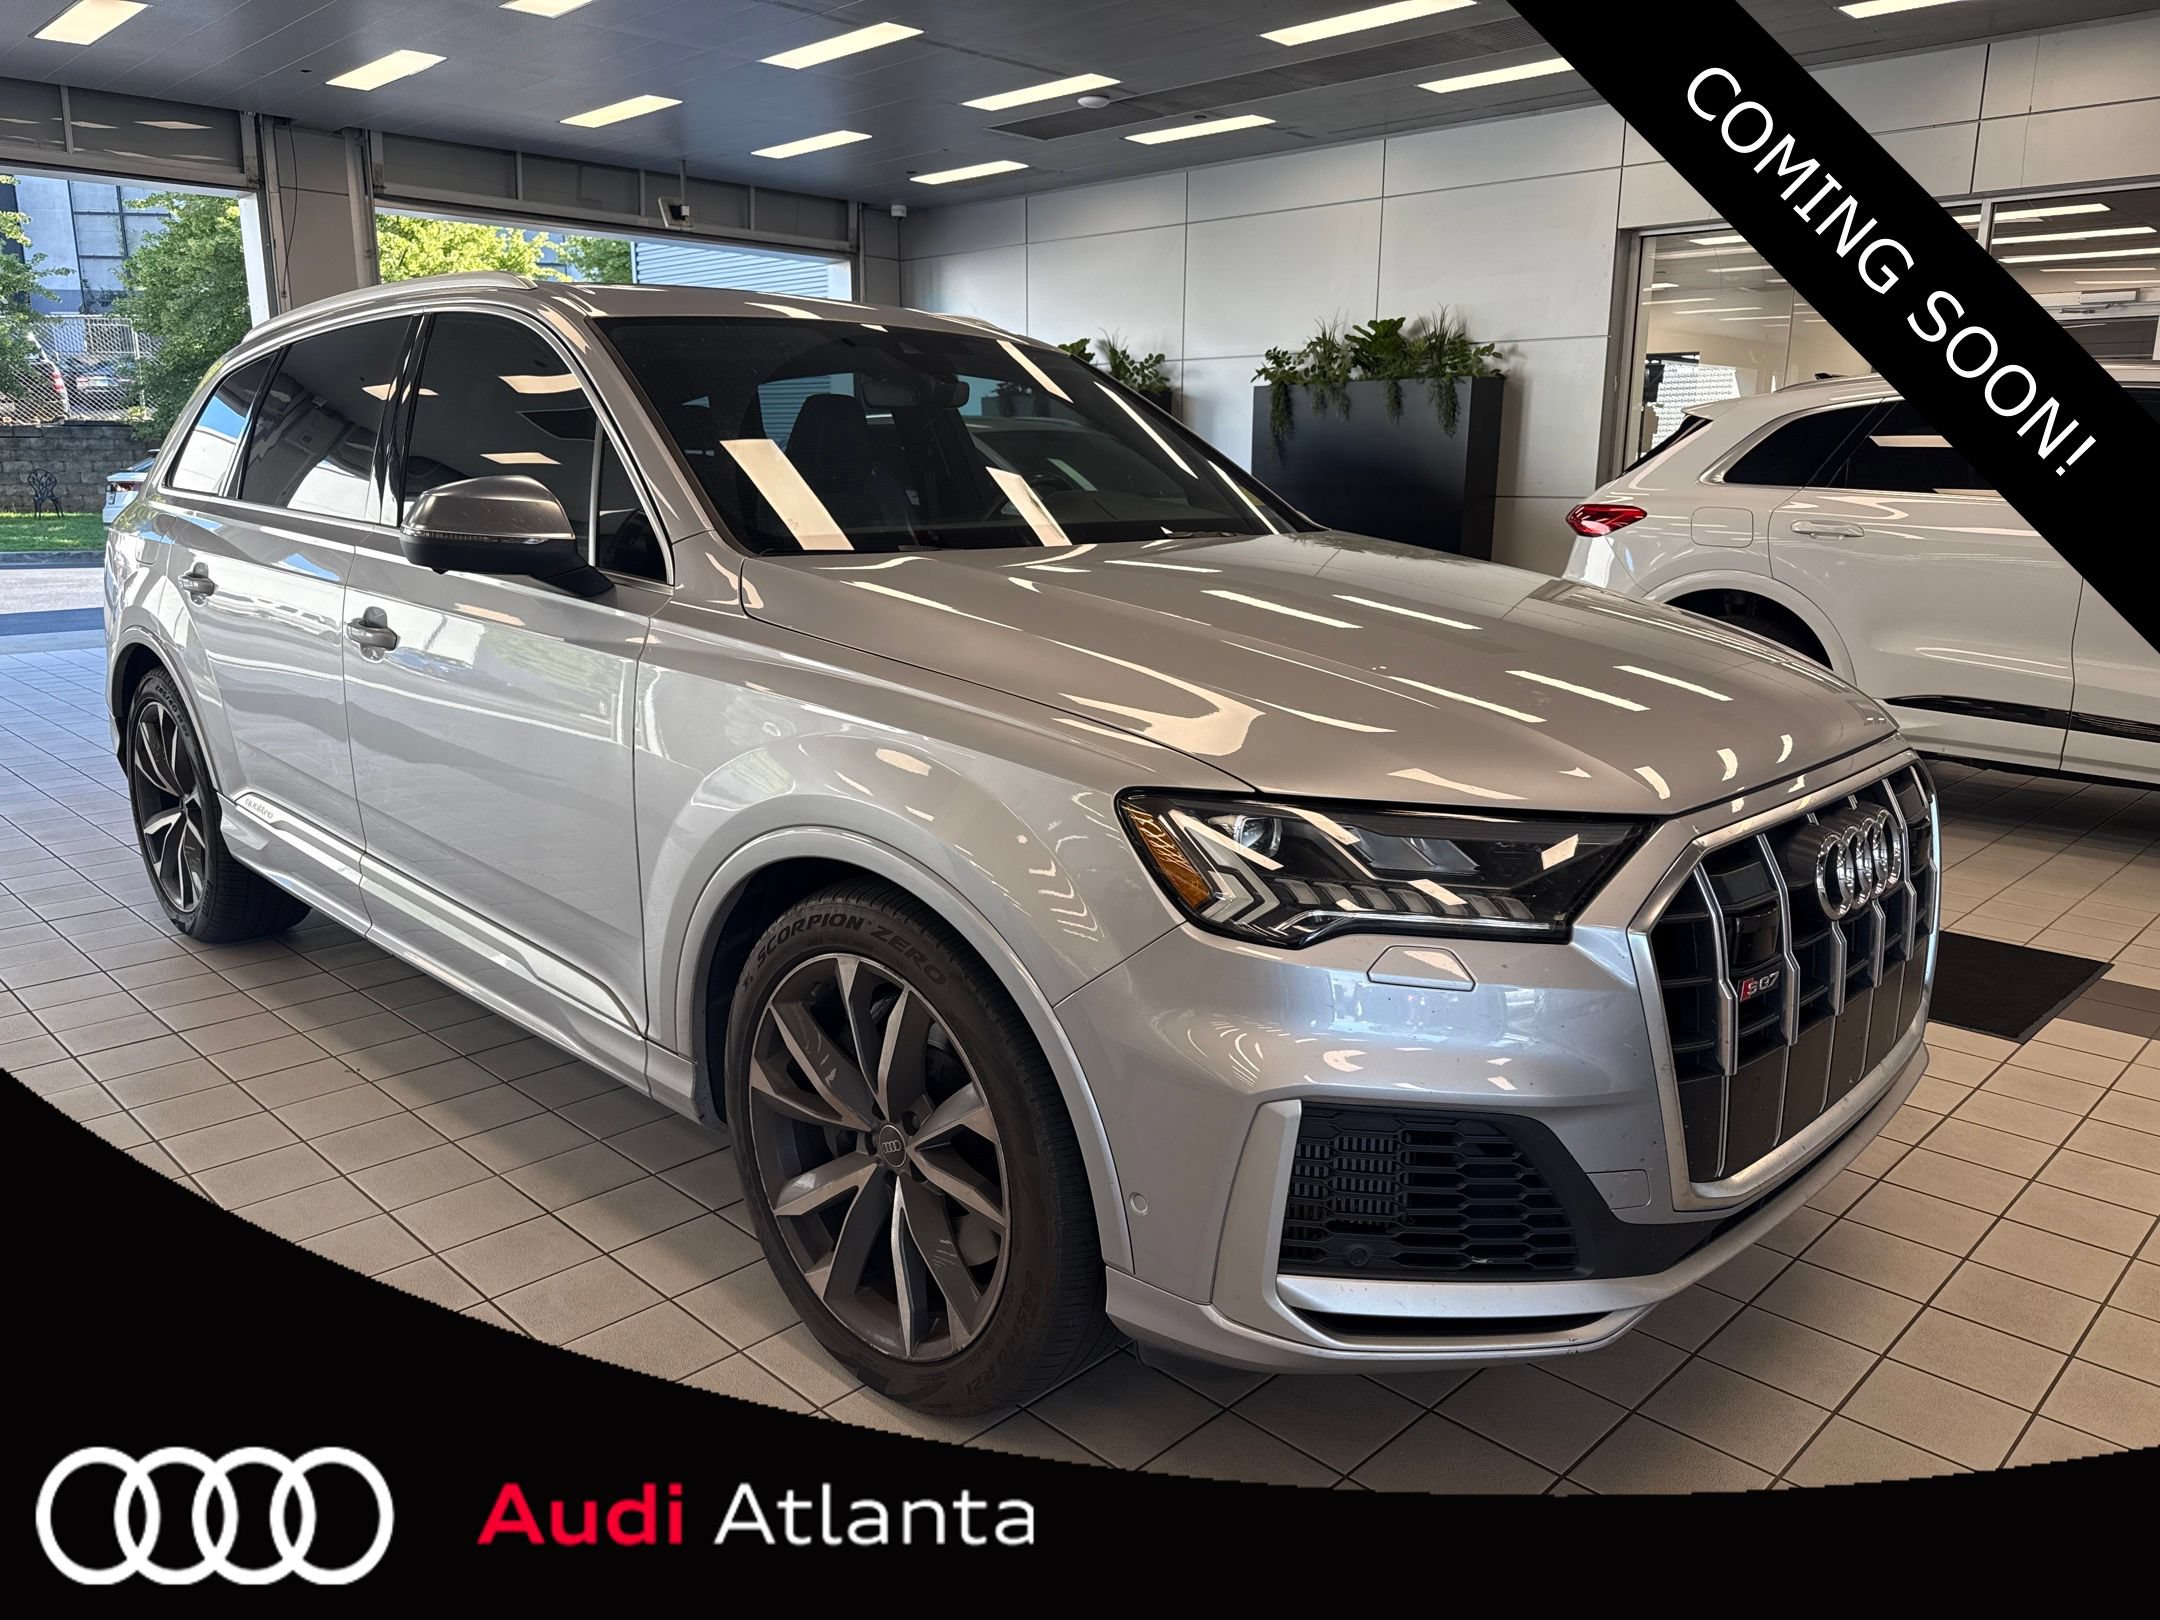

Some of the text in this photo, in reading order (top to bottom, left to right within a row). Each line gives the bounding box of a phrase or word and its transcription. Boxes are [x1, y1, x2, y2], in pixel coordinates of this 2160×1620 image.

[757, 912, 947, 986] SCORPION ZERO
[1745, 970, 1780, 997] SQ7
